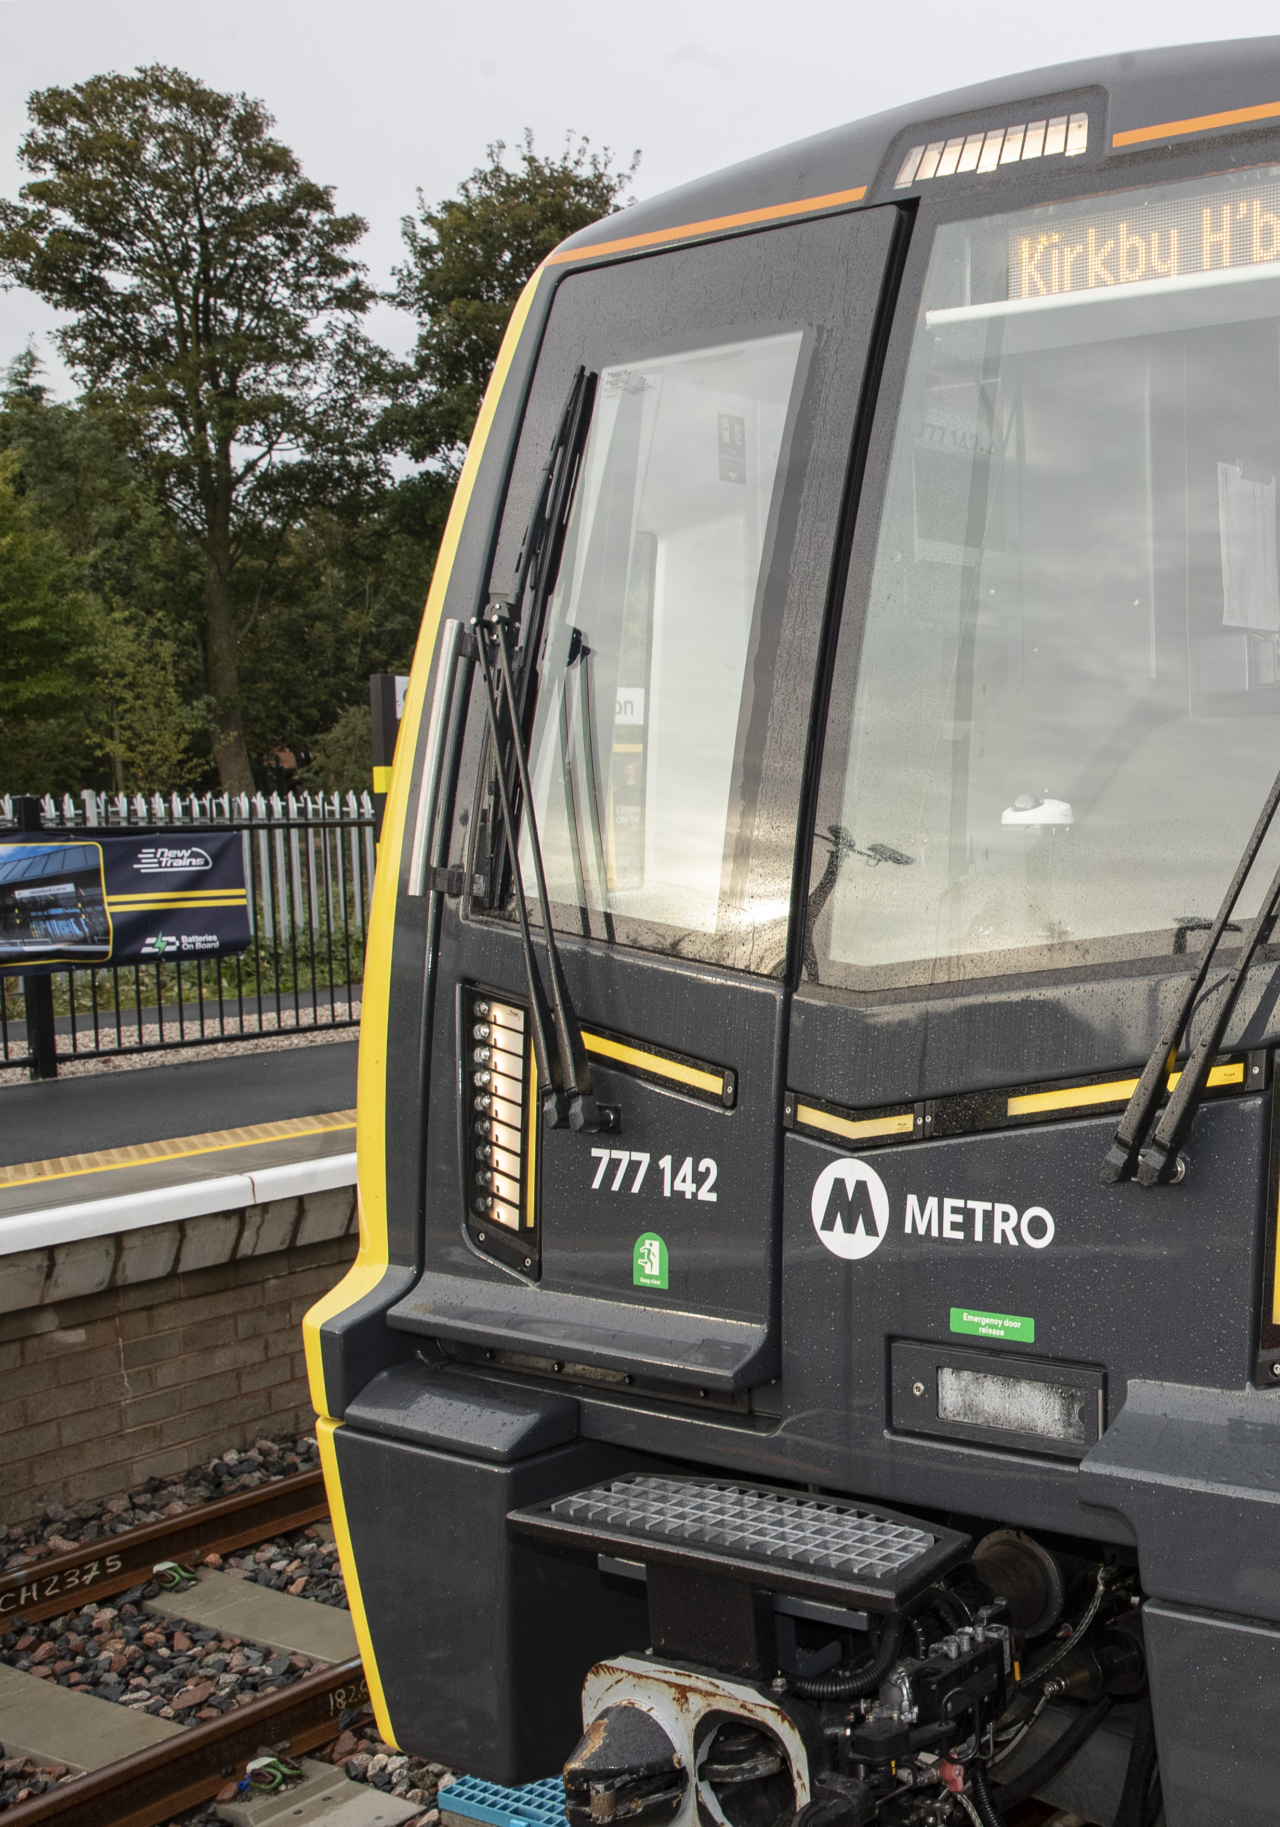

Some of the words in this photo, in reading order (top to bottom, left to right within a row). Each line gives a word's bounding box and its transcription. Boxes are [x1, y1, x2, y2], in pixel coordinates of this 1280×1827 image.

[1019, 222, 1179, 299] Kirkby
[156, 847, 192, 859] New
[159, 856, 206, 868] Trains
[181, 933, 218, 944] Batteries
[182, 942, 194, 951] On
[195, 940, 220, 950] Board
[591, 1148, 651, 1194] 777
[658, 1154, 718, 1202] 142
[904, 1194, 1055, 1249] METRO
[962, 1312, 1003, 1328] Emergency
[1003, 1318, 1022, 1329] door
[978, 1325, 1005, 1337] release
